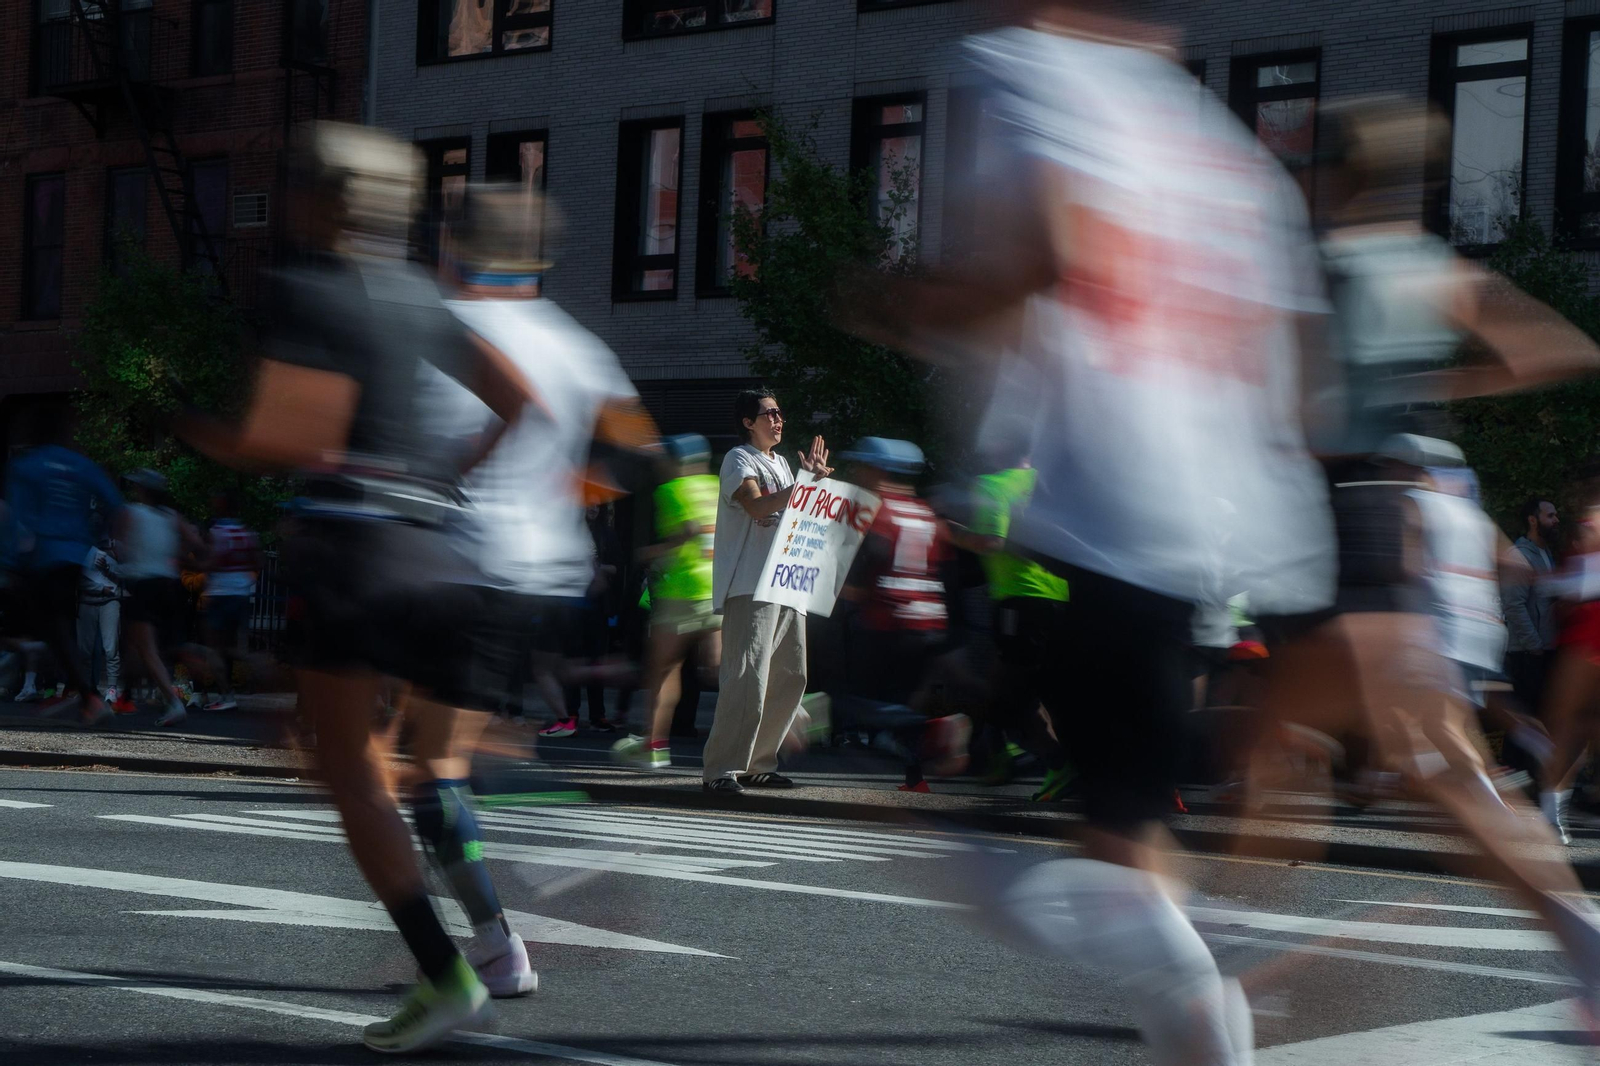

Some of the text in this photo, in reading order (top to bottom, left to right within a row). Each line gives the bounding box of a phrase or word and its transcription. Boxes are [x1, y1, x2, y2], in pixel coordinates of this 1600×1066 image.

[810, 489, 872, 533] RACING
[793, 535, 806, 546] ANY
[789, 548, 813, 560] ANY DAY
[771, 564, 819, 594] FOREVER
